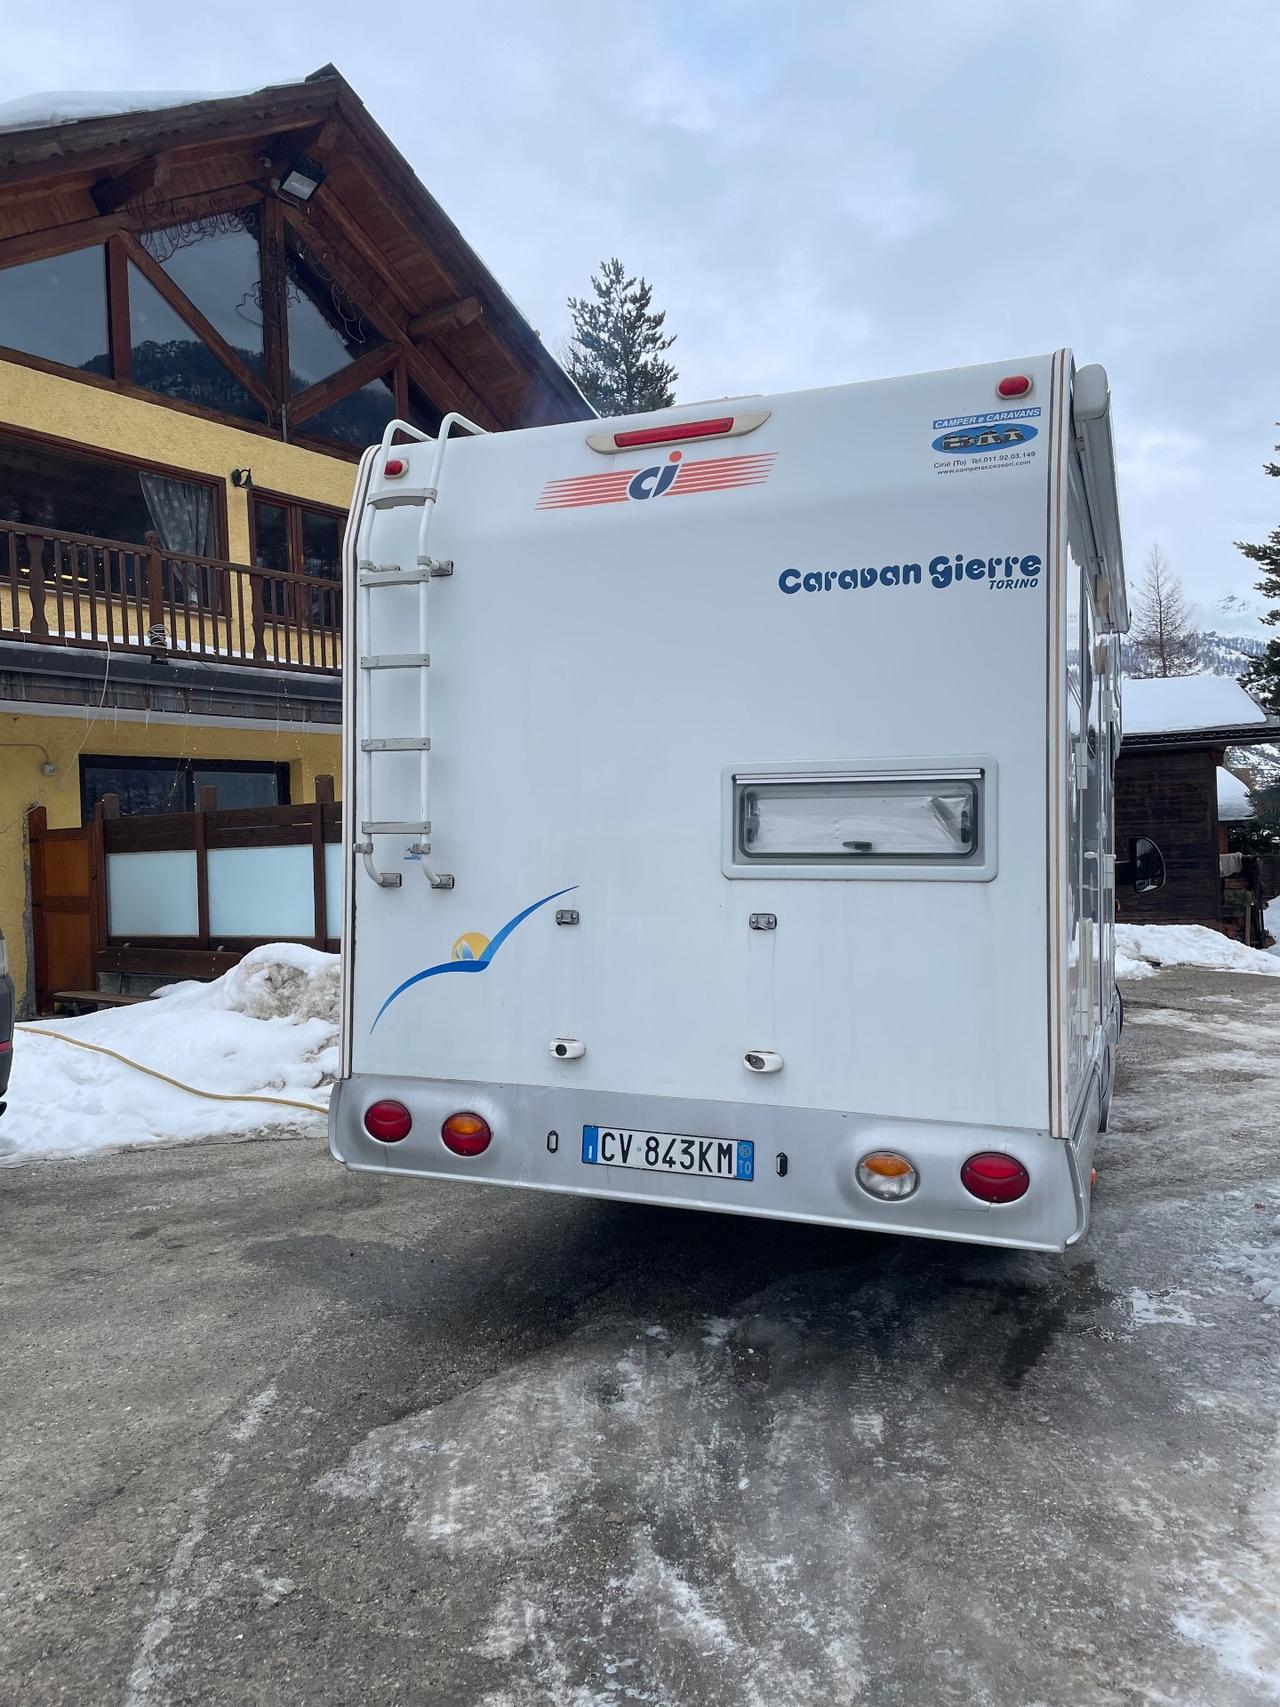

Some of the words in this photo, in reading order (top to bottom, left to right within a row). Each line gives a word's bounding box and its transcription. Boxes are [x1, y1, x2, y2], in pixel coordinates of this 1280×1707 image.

[934, 416, 977, 429] CAMPER
[985, 407, 1041, 422] CARAVANS
[778, 563, 922, 595] Caravan
[928, 554, 1042, 589] Gierre
[988, 578, 1039, 590] TORINO
[601, 1131, 633, 1164] CV
[644, 1135, 733, 1175] 843KM
[738, 1160, 752, 1175] TO
